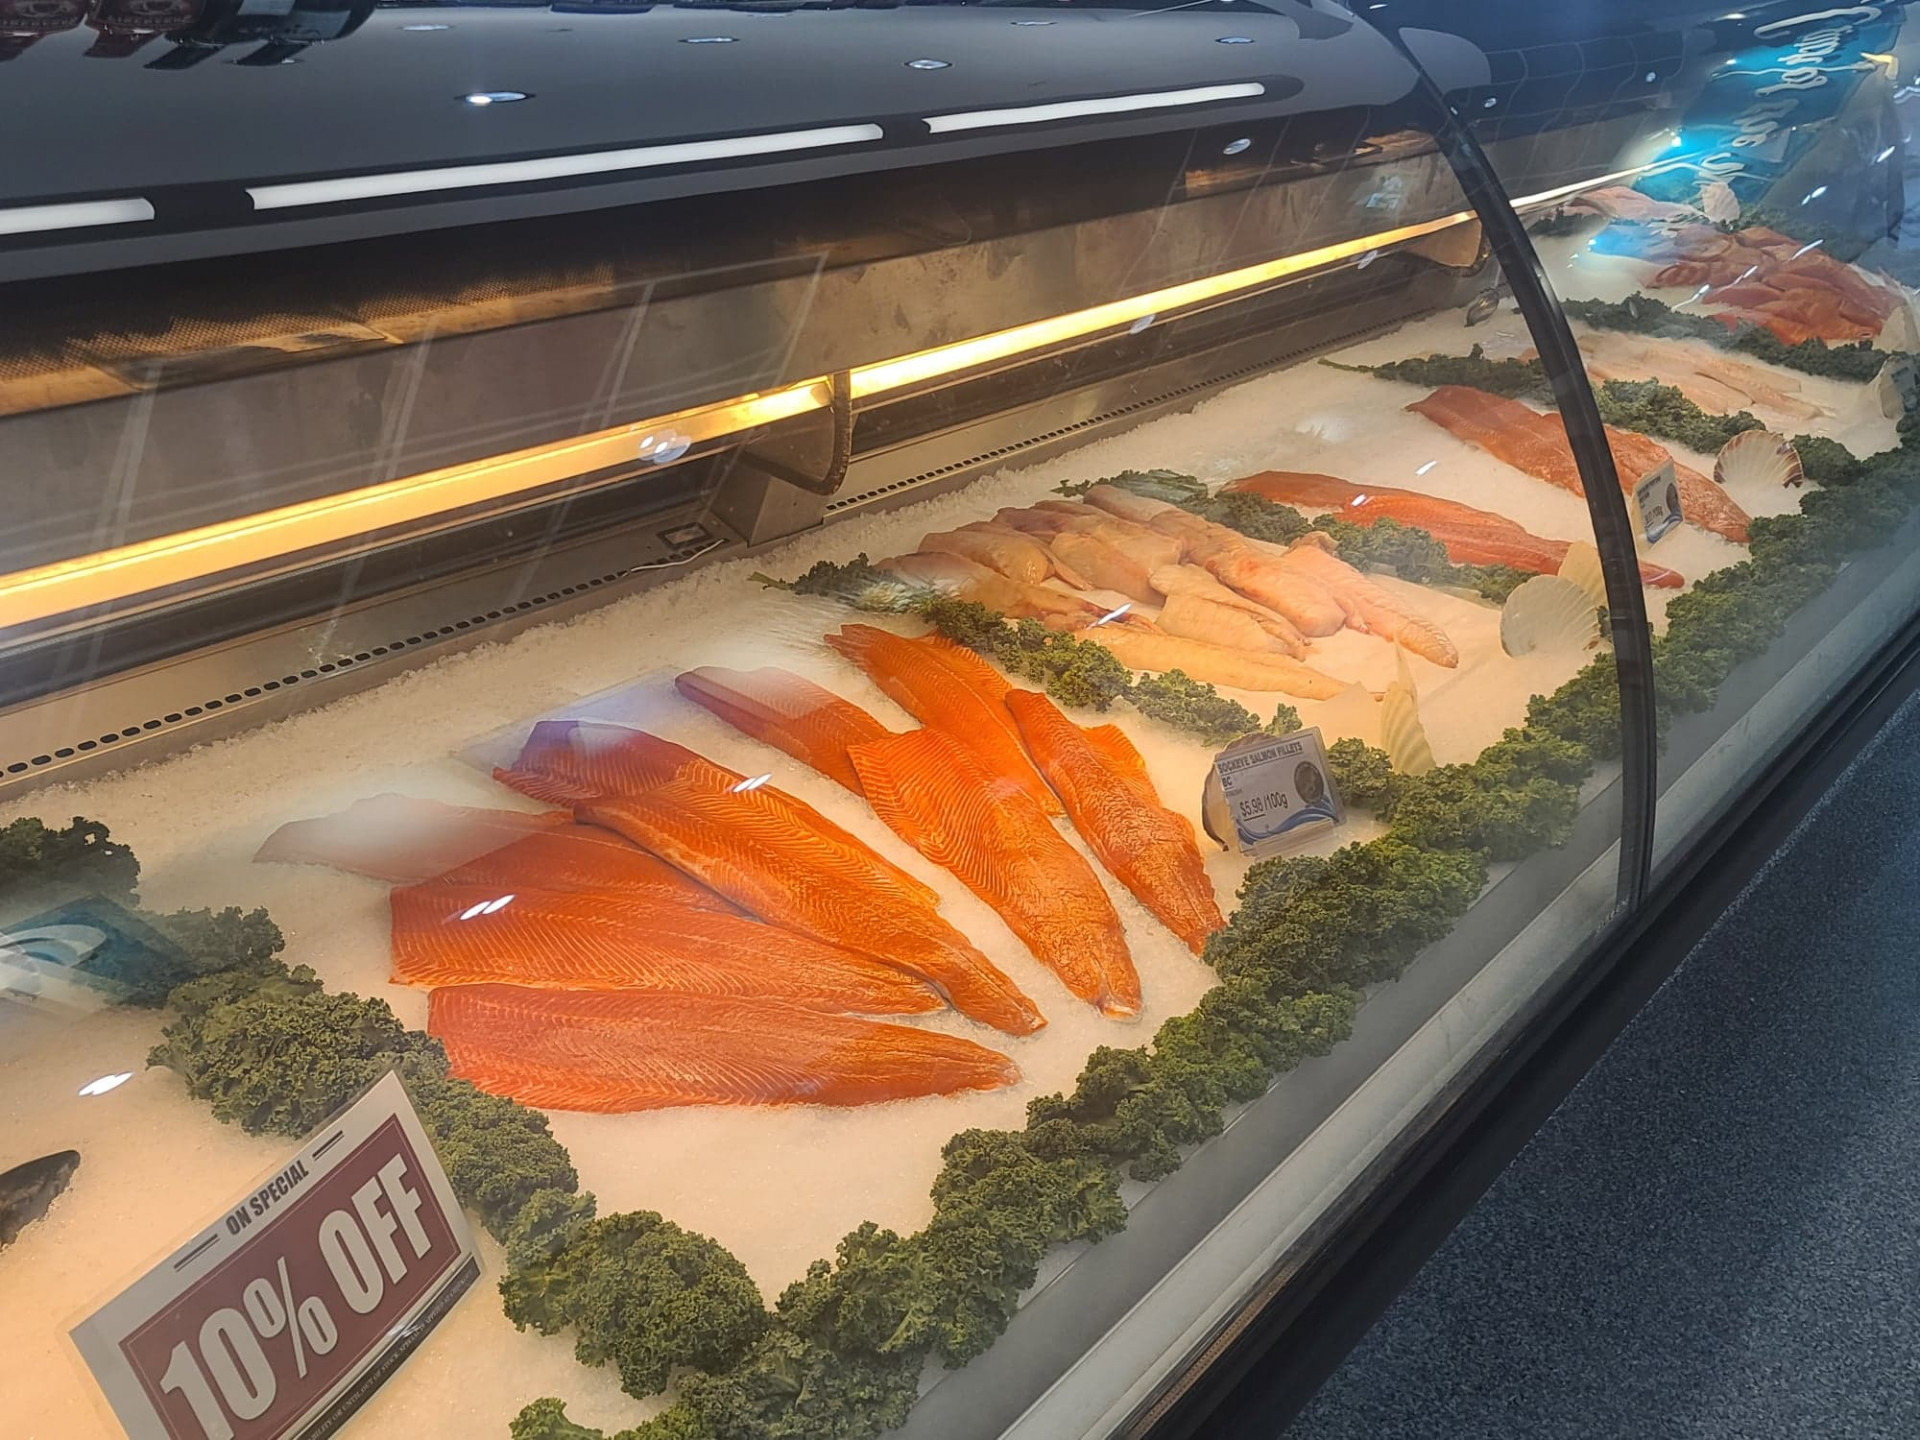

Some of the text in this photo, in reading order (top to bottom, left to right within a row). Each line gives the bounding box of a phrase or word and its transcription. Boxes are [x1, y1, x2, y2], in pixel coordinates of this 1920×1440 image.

[1217, 741, 1303, 774] SOCKEYE SALMON FILLETS
[1222, 776, 1233, 788] BC
[226, 1160, 309, 1236] ON SPECIAL
[159, 1153, 432, 1440] 10% OFF
